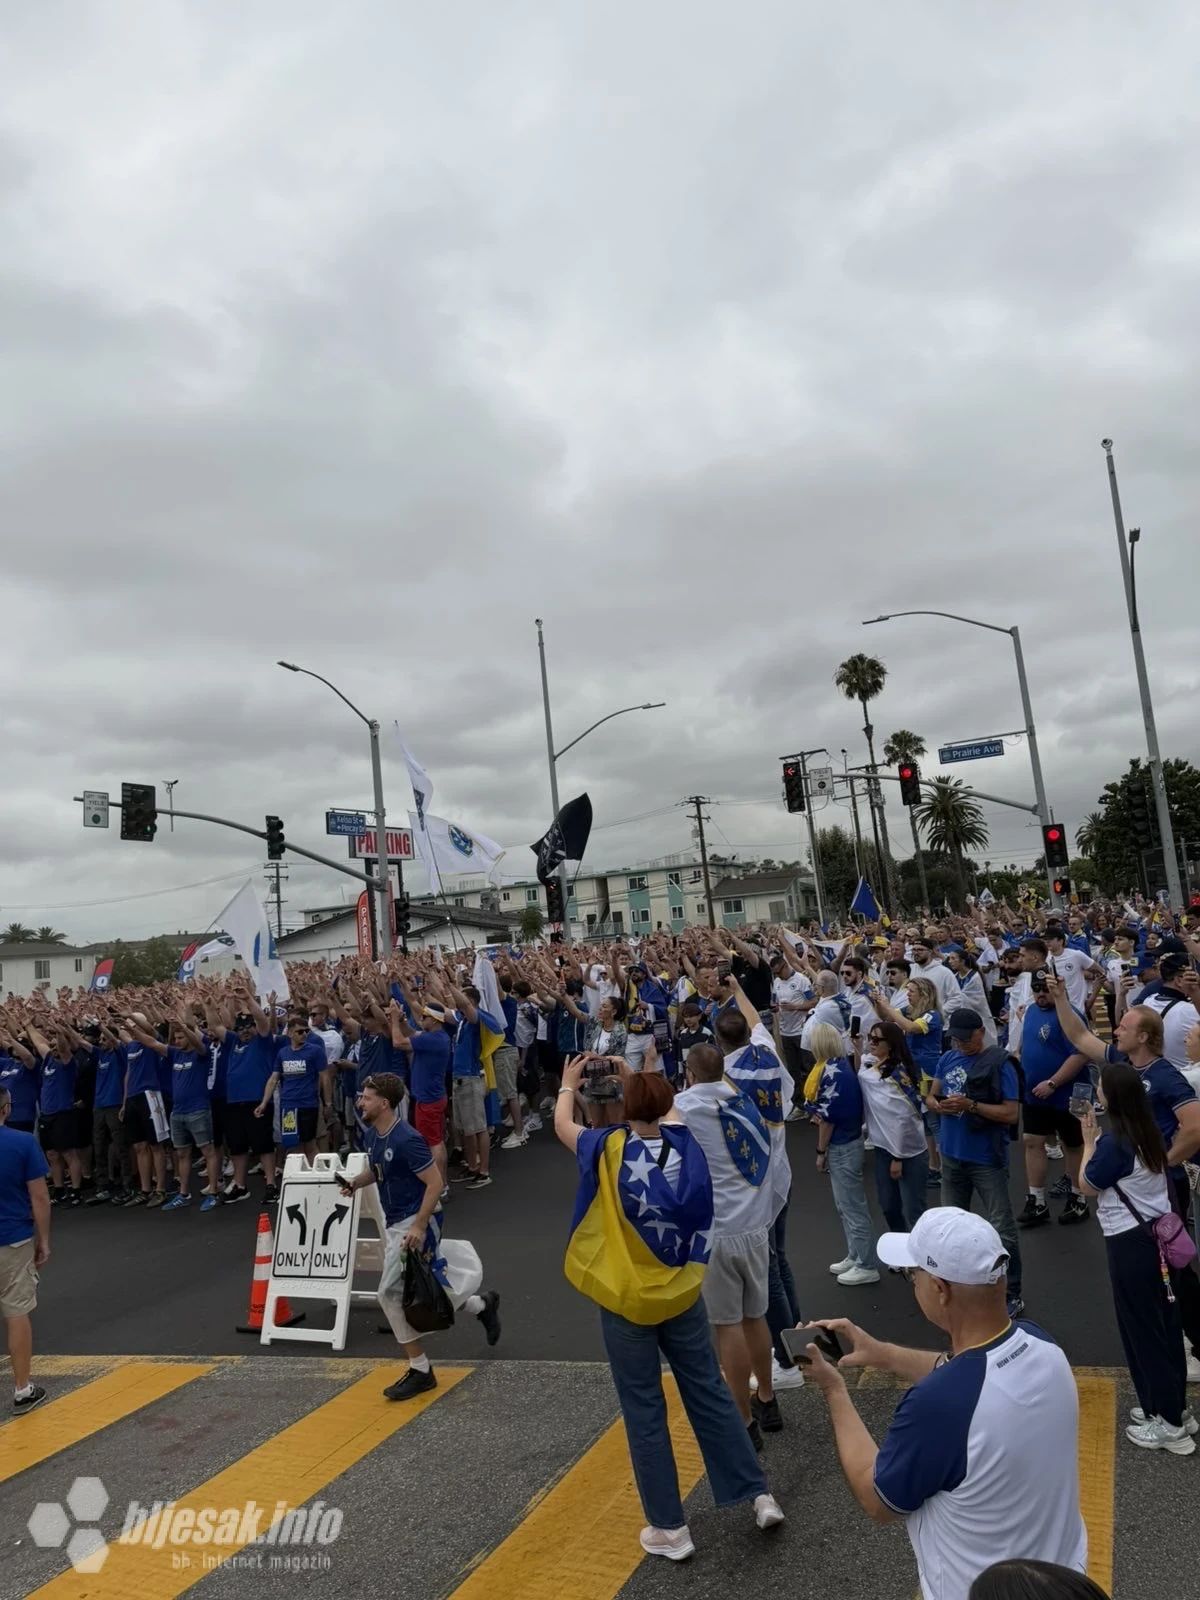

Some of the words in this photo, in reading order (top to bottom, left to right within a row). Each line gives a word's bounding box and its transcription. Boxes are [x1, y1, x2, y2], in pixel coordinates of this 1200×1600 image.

[952, 746, 981, 758] Prairie
[983, 744, 1001, 754] Ave
[276, 1252, 309, 1267] ONLY
[314, 1252, 346, 1268] ONLY
